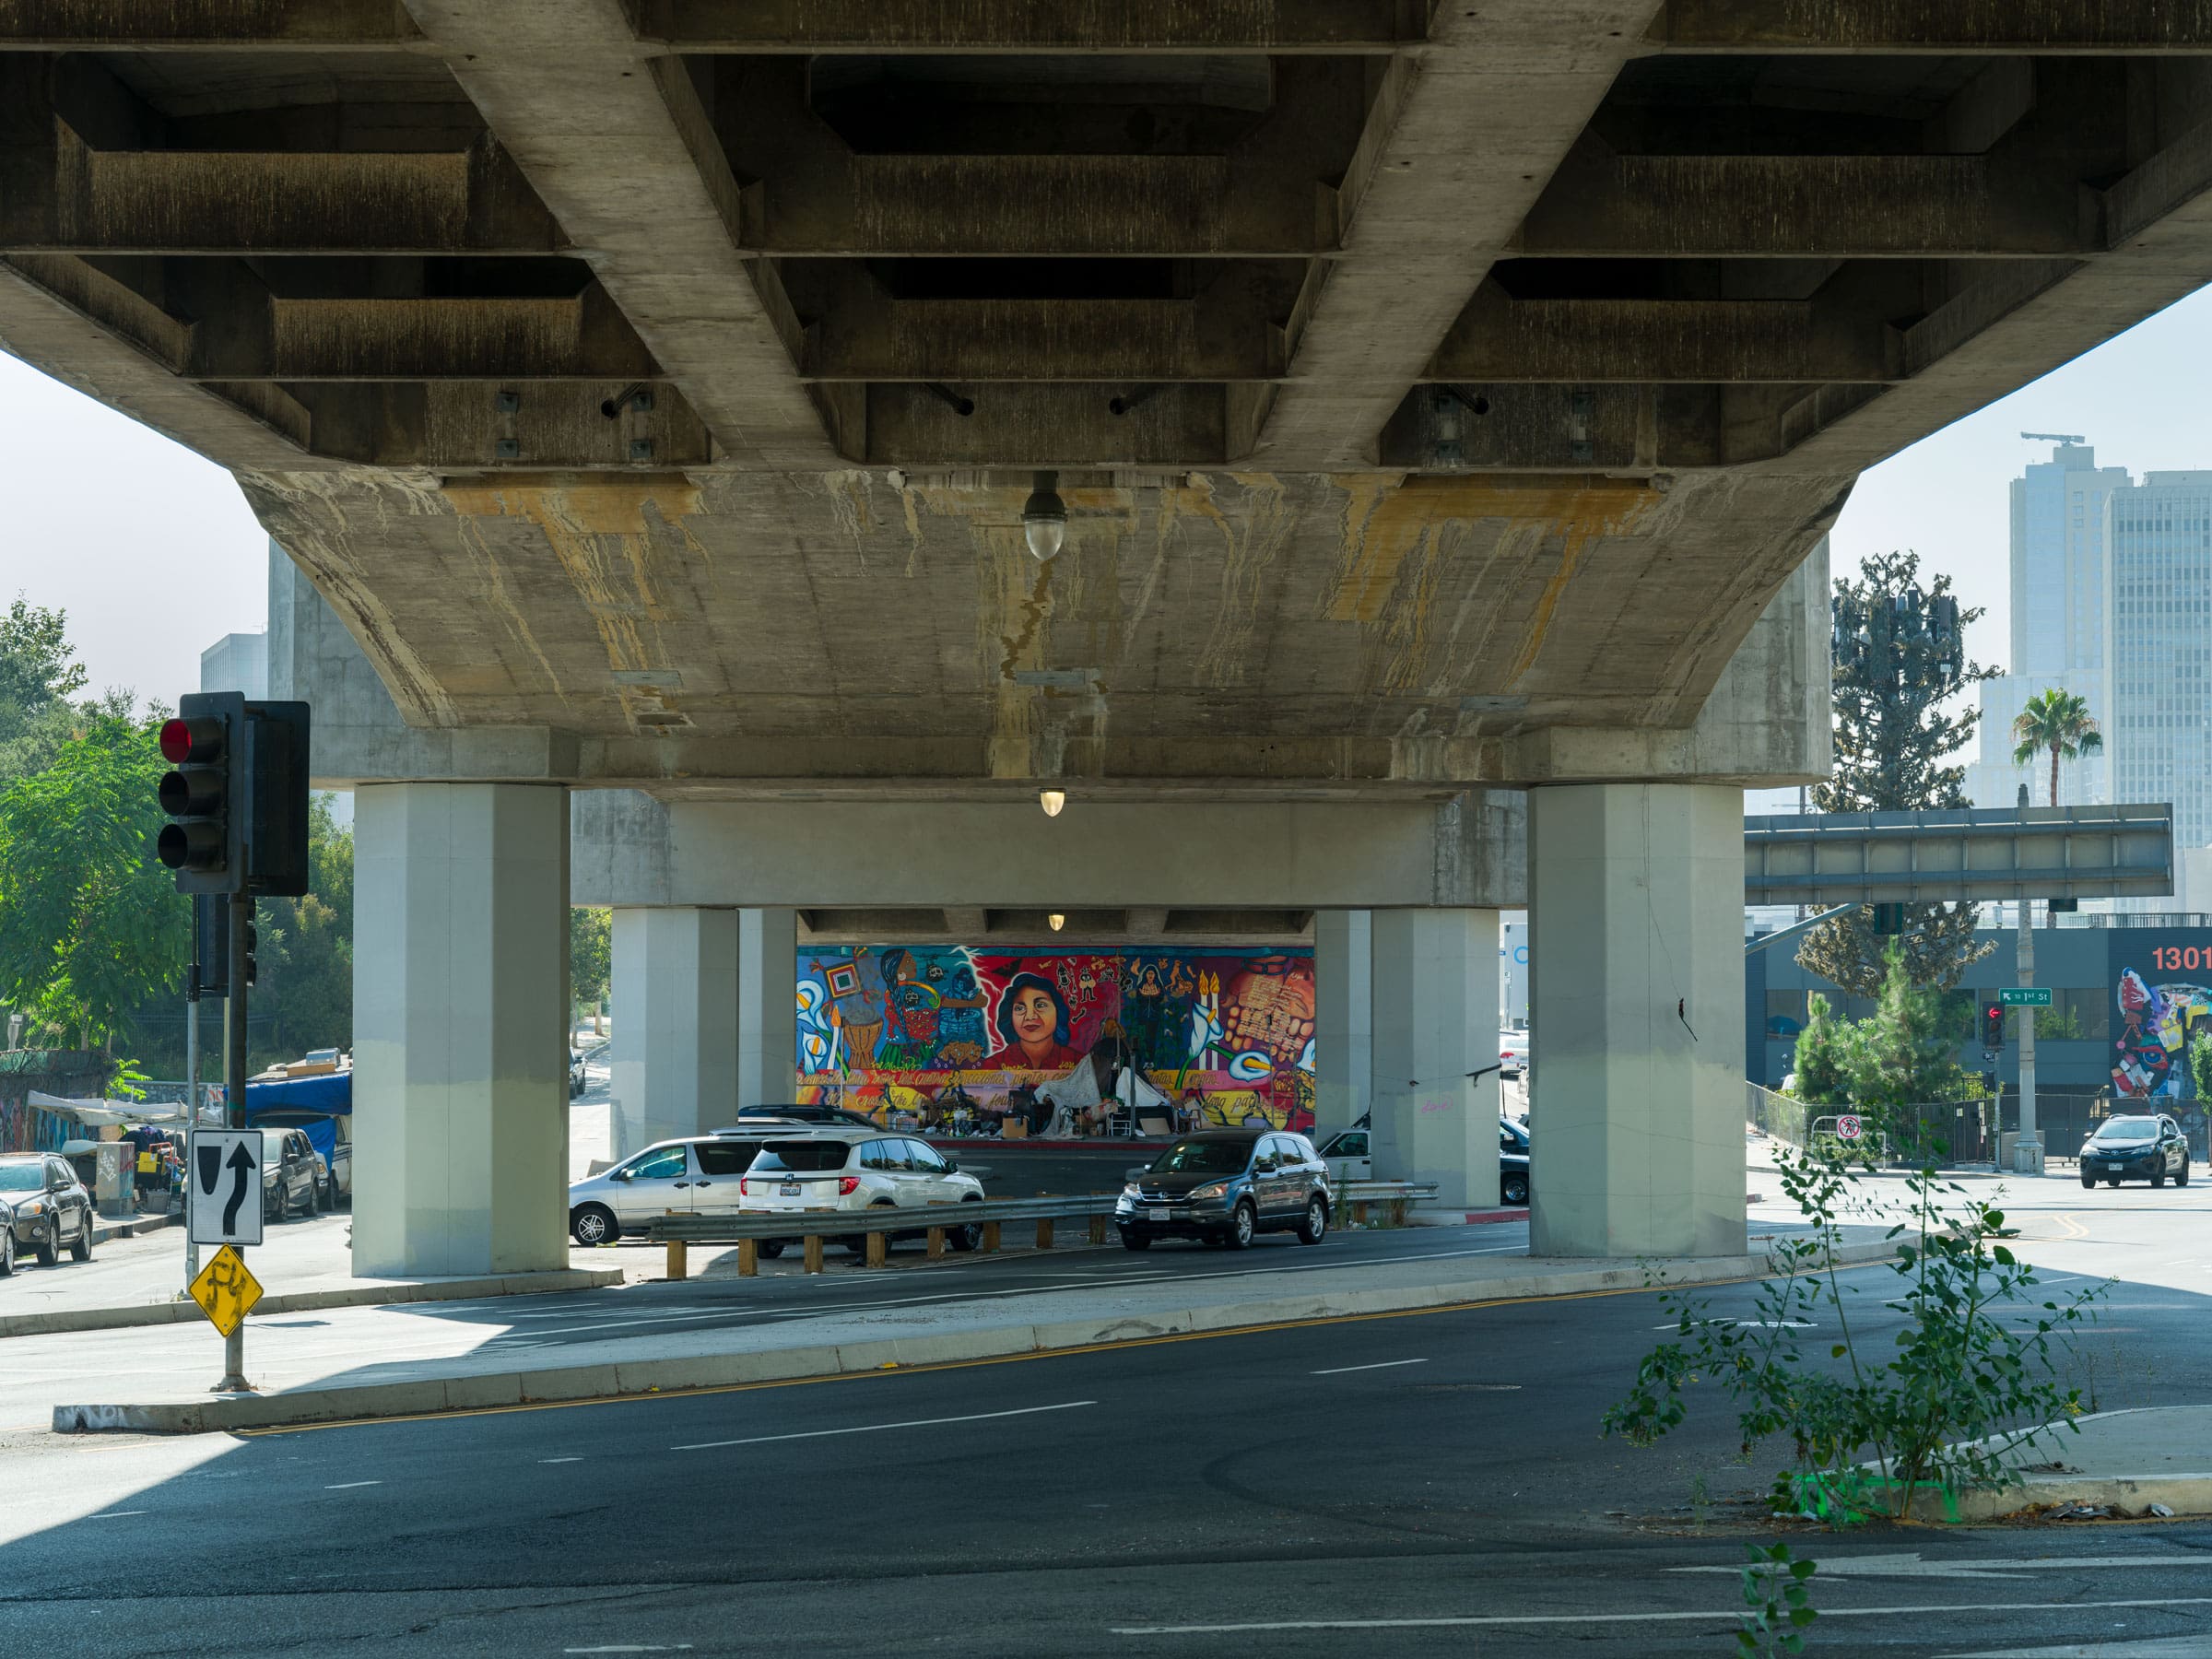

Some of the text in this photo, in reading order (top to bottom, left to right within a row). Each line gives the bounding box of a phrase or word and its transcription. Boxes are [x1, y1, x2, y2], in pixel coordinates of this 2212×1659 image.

[2152, 947, 2212, 971] 1301
[2038, 993, 2048, 1001] St
[987, 1093, 1009, 1110] fou
